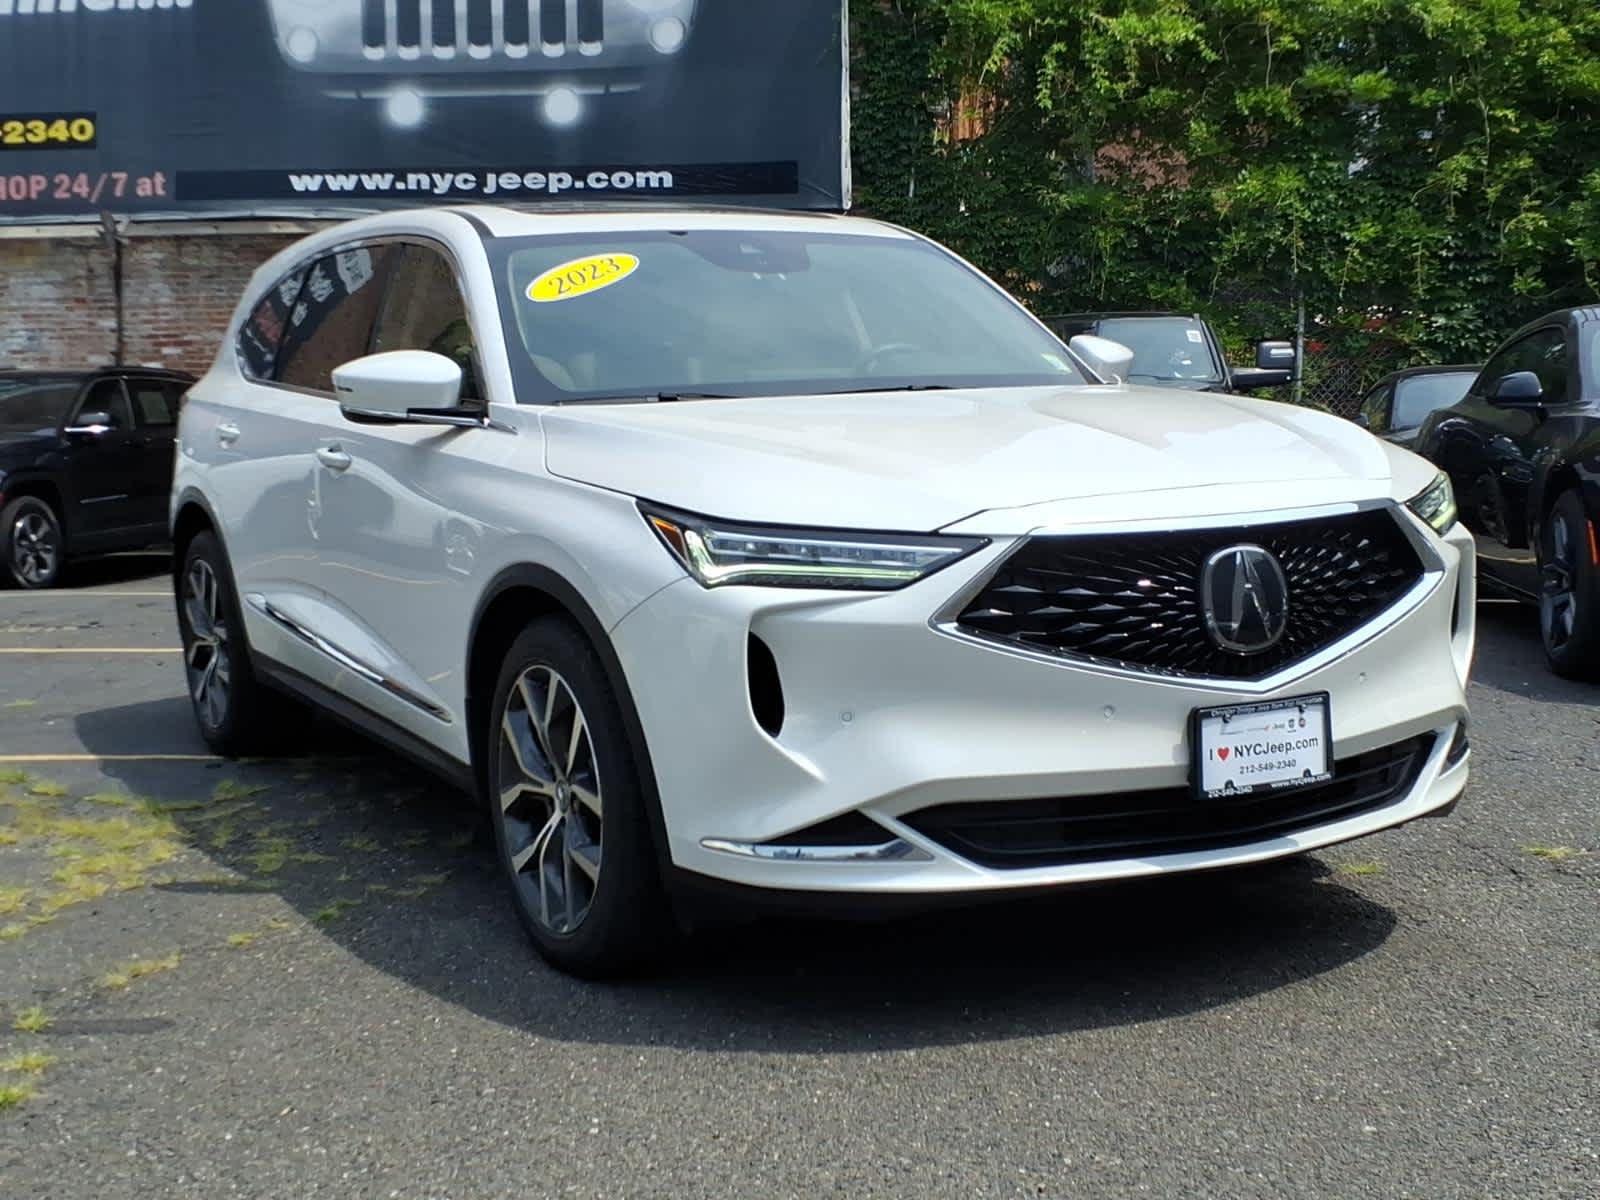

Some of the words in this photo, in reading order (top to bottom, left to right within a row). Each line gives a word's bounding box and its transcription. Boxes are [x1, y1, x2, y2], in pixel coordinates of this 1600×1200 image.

[0, 118, 94, 144] 2340
[53, 172, 128, 203] 24/7
[136, 171, 166, 197] at
[548, 258, 620, 294] 2023
[1234, 737, 1319, 758] NYCJeep.com
[1239, 759, 1297, 774] 212-549-2340
